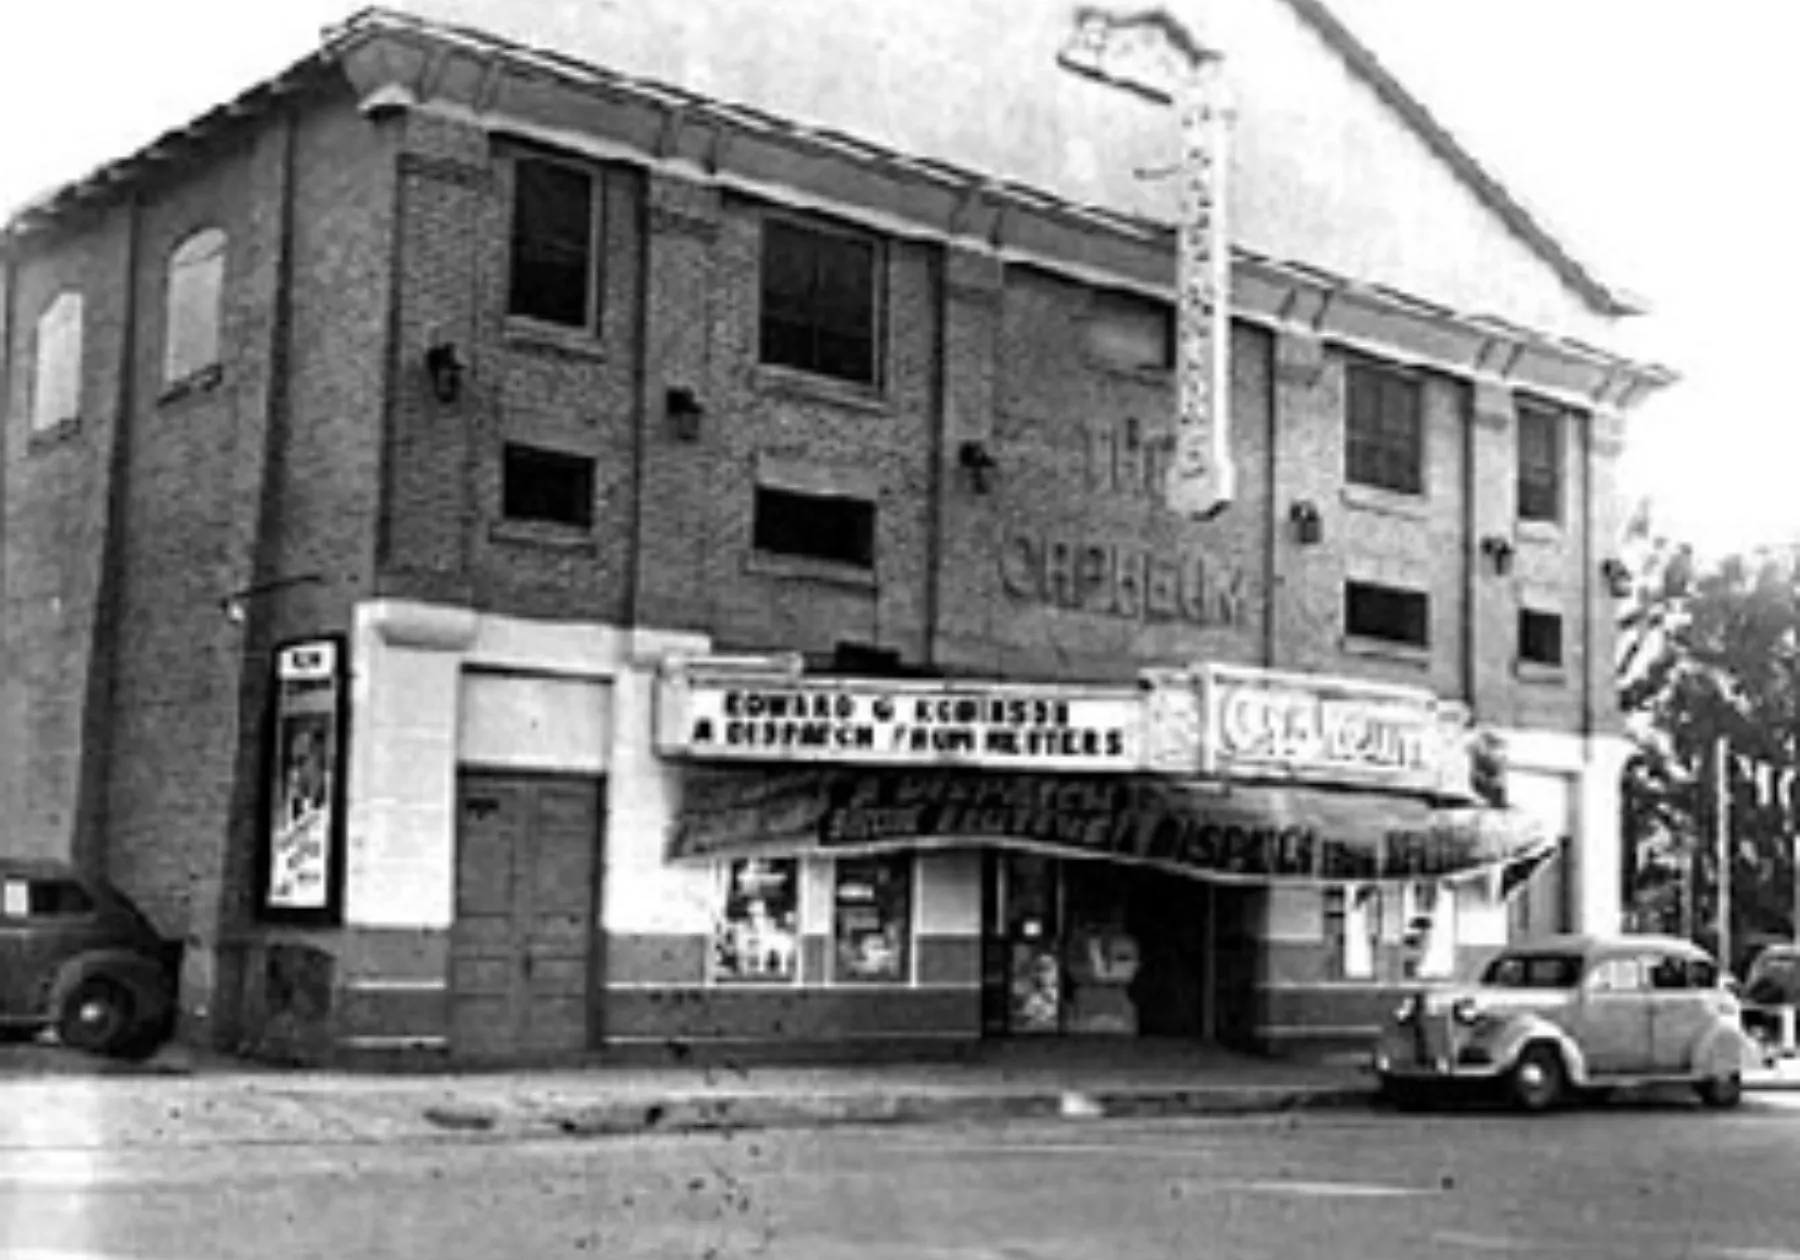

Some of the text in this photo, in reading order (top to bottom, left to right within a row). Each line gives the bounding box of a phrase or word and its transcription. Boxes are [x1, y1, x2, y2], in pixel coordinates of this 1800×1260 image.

[997, 535, 1248, 627] ORPHEUM
[723, 690, 855, 719] EDWARD
[914, 697, 1070, 726] ROBINSON
[693, 717, 714, 743] A
[725, 720, 875, 749] DISPATCH
[893, 723, 977, 755] FROM
